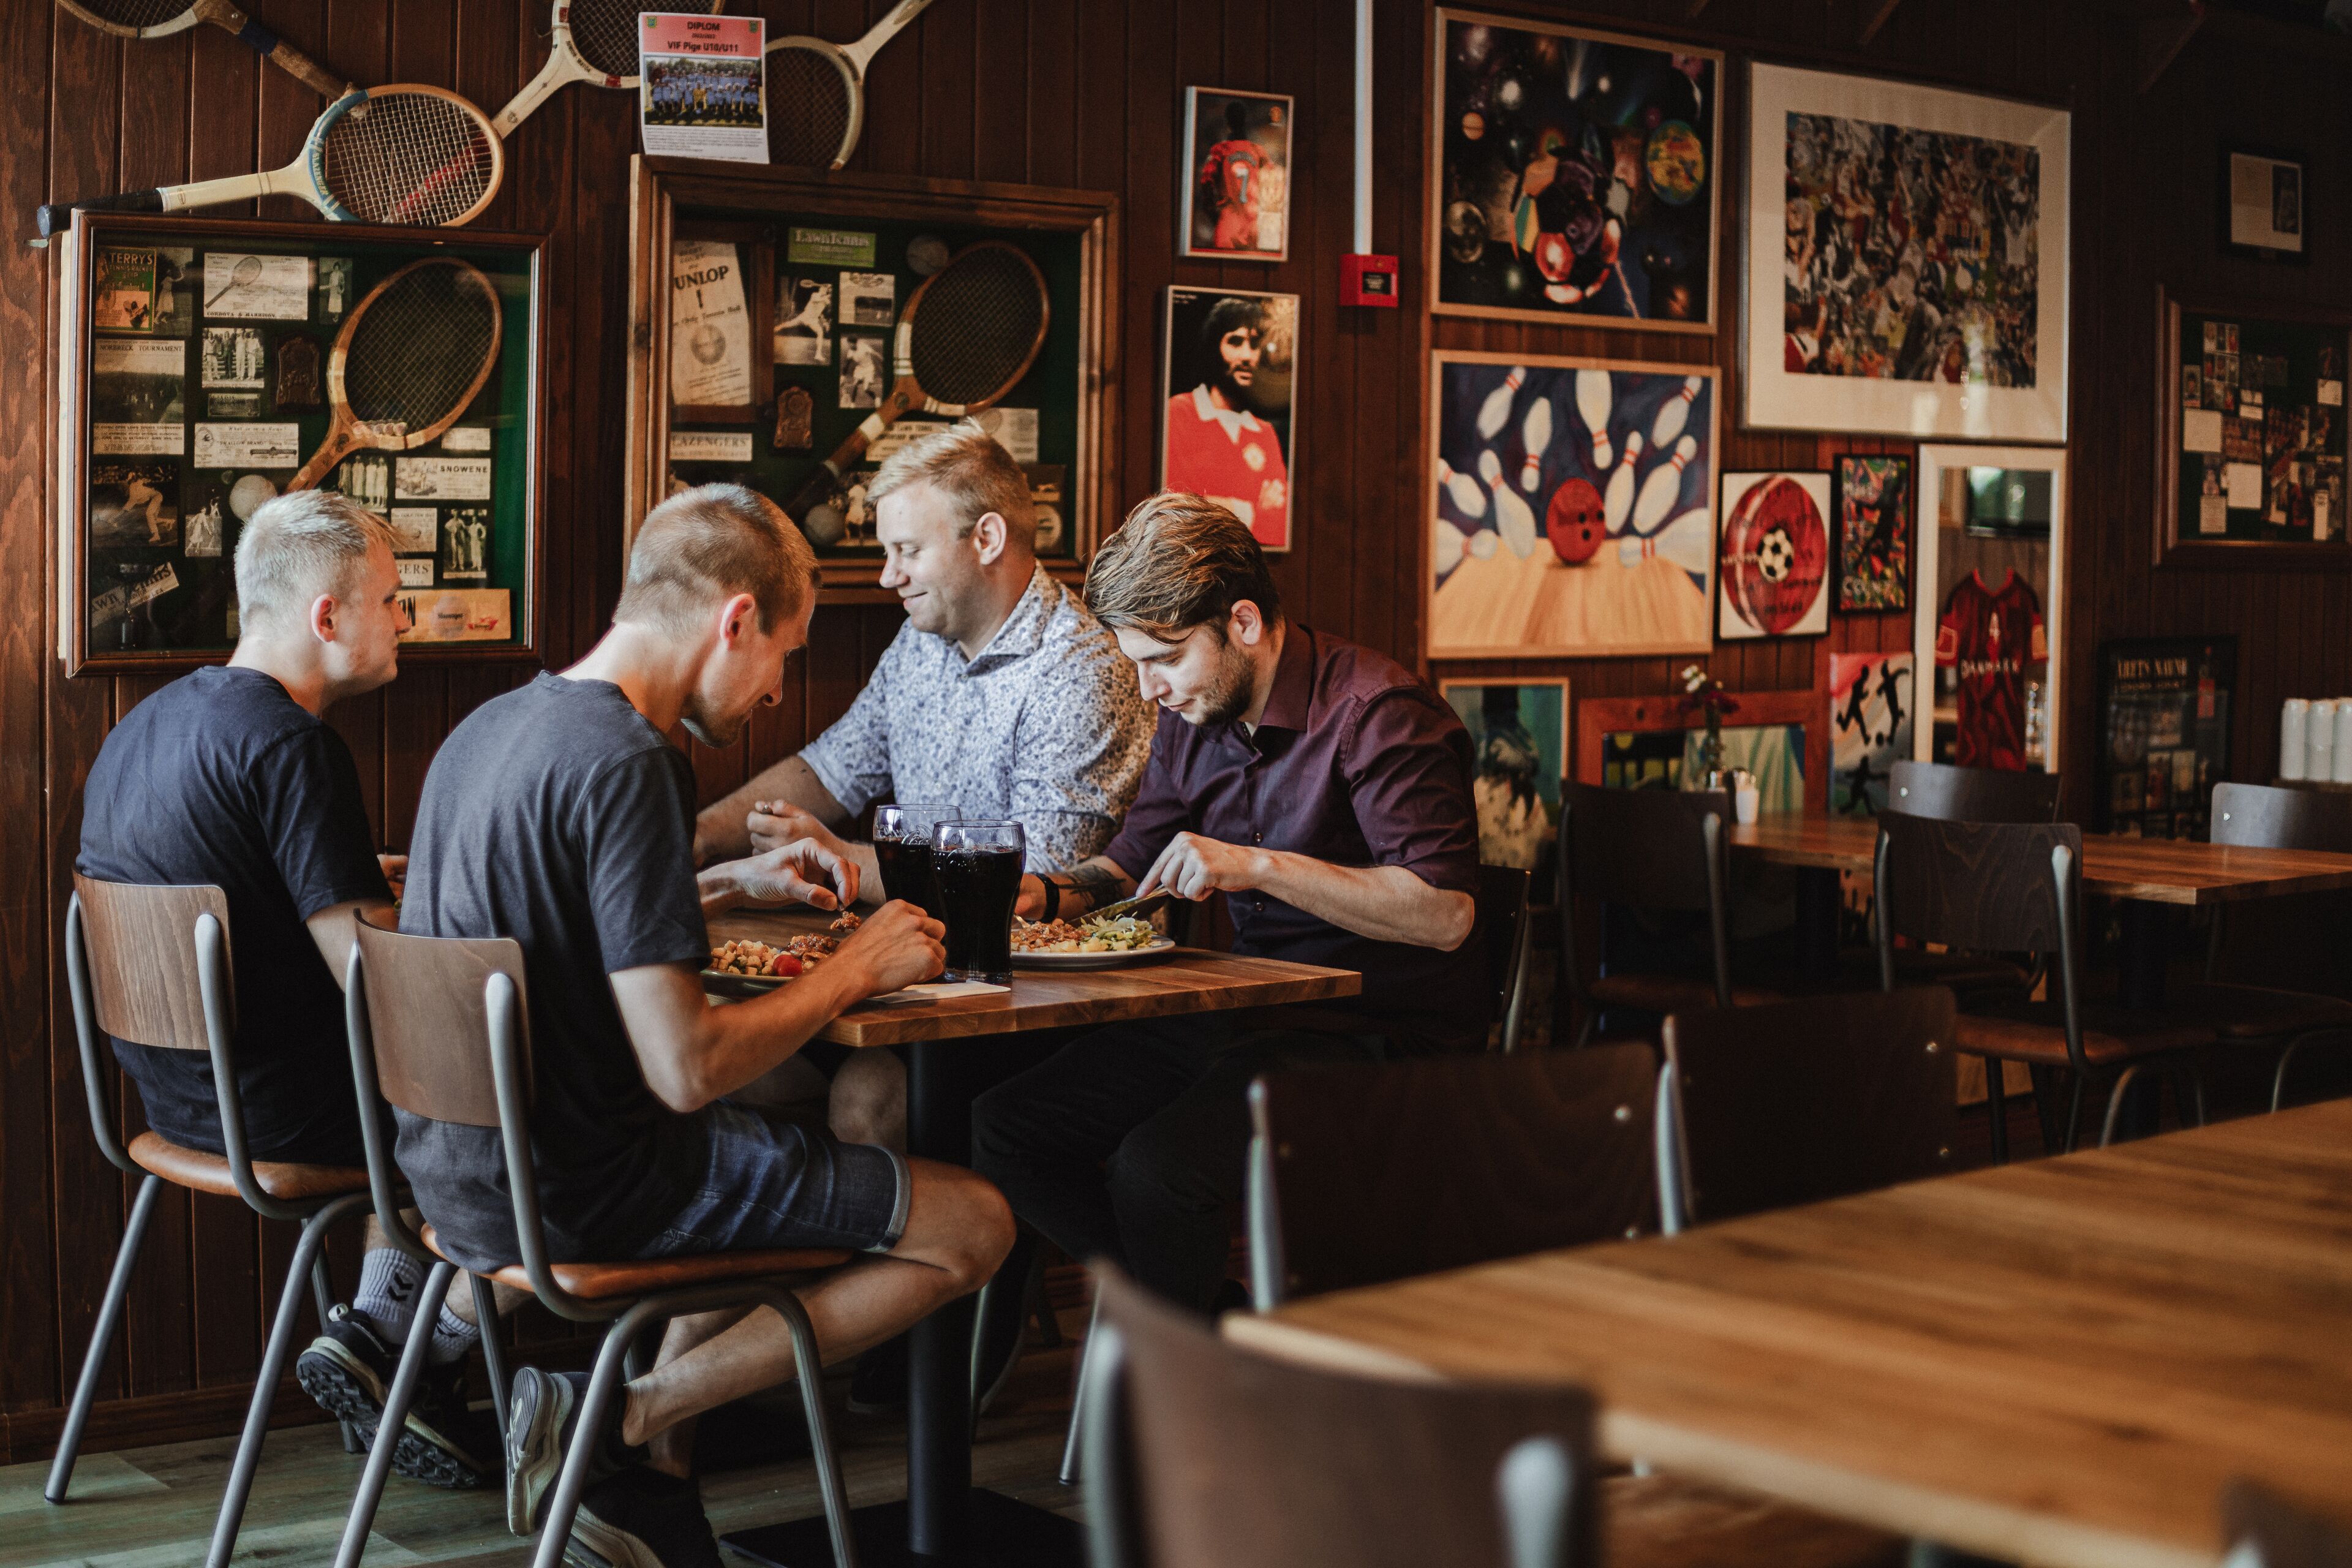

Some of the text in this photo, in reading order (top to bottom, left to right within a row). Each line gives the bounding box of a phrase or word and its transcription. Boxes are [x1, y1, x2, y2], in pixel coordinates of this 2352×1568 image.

[687, 21, 720, 31] DIPLOM
[668, 40, 680, 49] VIF
[703, 42, 739, 52] U10/U11
[1234, 167, 1250, 203] 7
[673, 265, 729, 290] UNLOP
